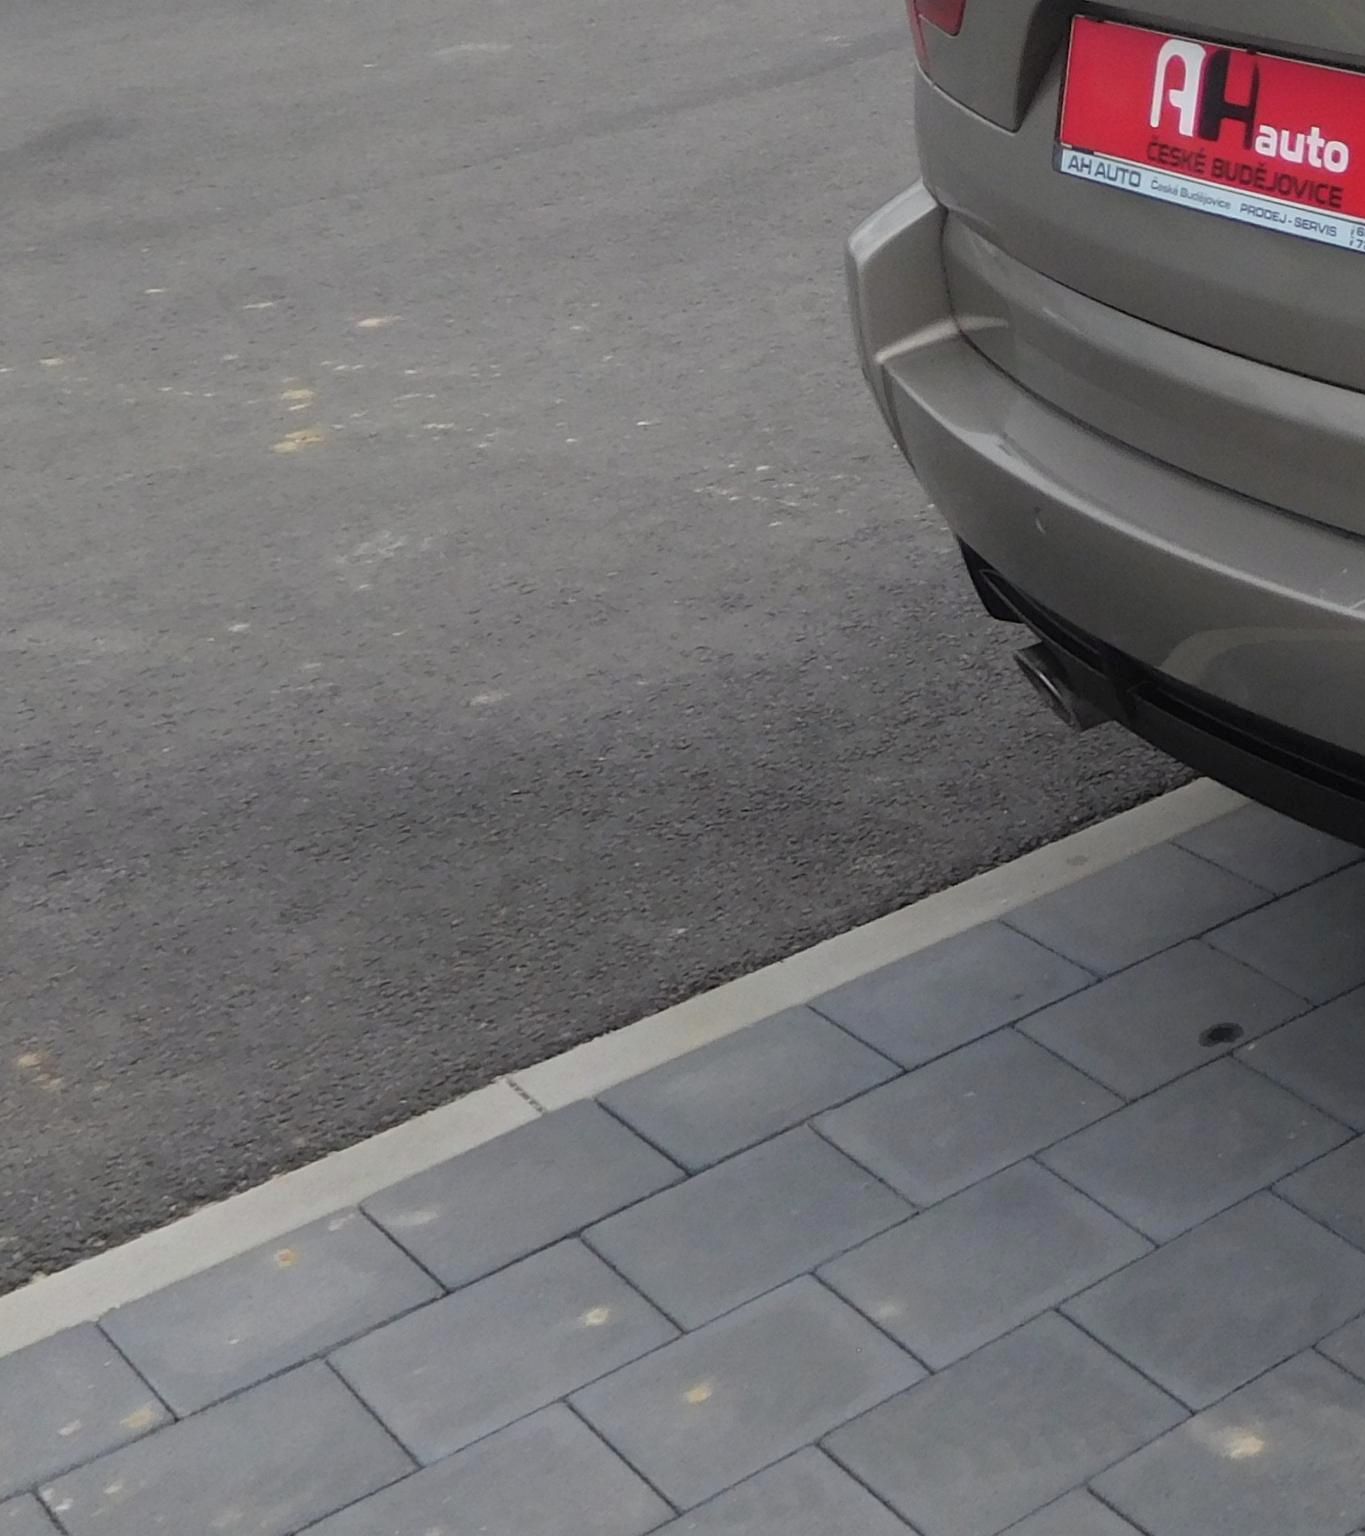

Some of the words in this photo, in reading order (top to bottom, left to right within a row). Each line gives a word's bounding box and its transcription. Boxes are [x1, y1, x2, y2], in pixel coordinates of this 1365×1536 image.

[1150, 38, 1260, 151] AH
[1254, 124, 1350, 173] auto
[1067, 154, 1093, 176] AH
[1094, 162, 1142, 188] AUTO
[1146, 136, 1207, 174] ČESKÉ
[1211, 157, 1345, 209] BUDĚJOVICE
[1239, 202, 1288, 224] PRODEJ
[1293, 216, 1338, 238] SERVIS
